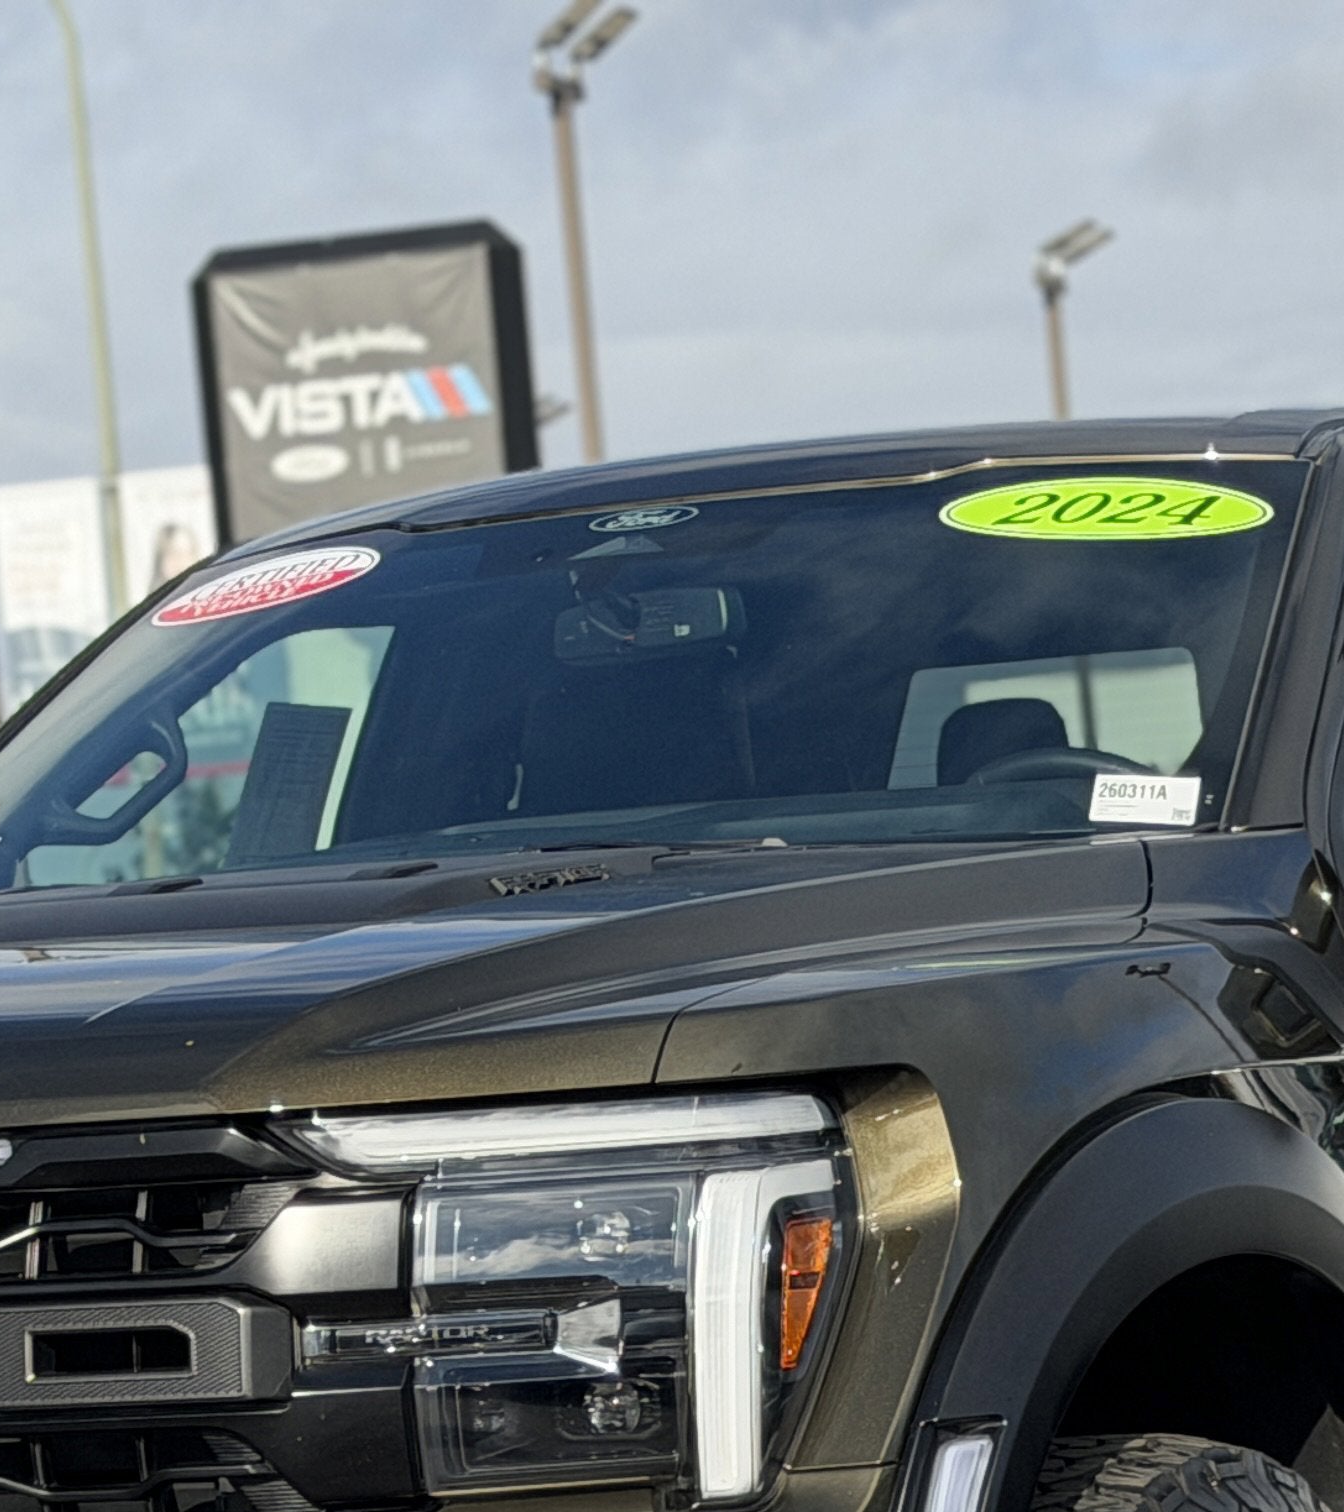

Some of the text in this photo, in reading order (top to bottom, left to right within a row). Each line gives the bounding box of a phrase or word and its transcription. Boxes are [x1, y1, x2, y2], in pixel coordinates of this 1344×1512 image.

[227, 371, 425, 439] VISTA
[991, 492, 1222, 527] 2024
[189, 553, 362, 603] CERTIFIED
[1097, 782, 1168, 801] 260311A
